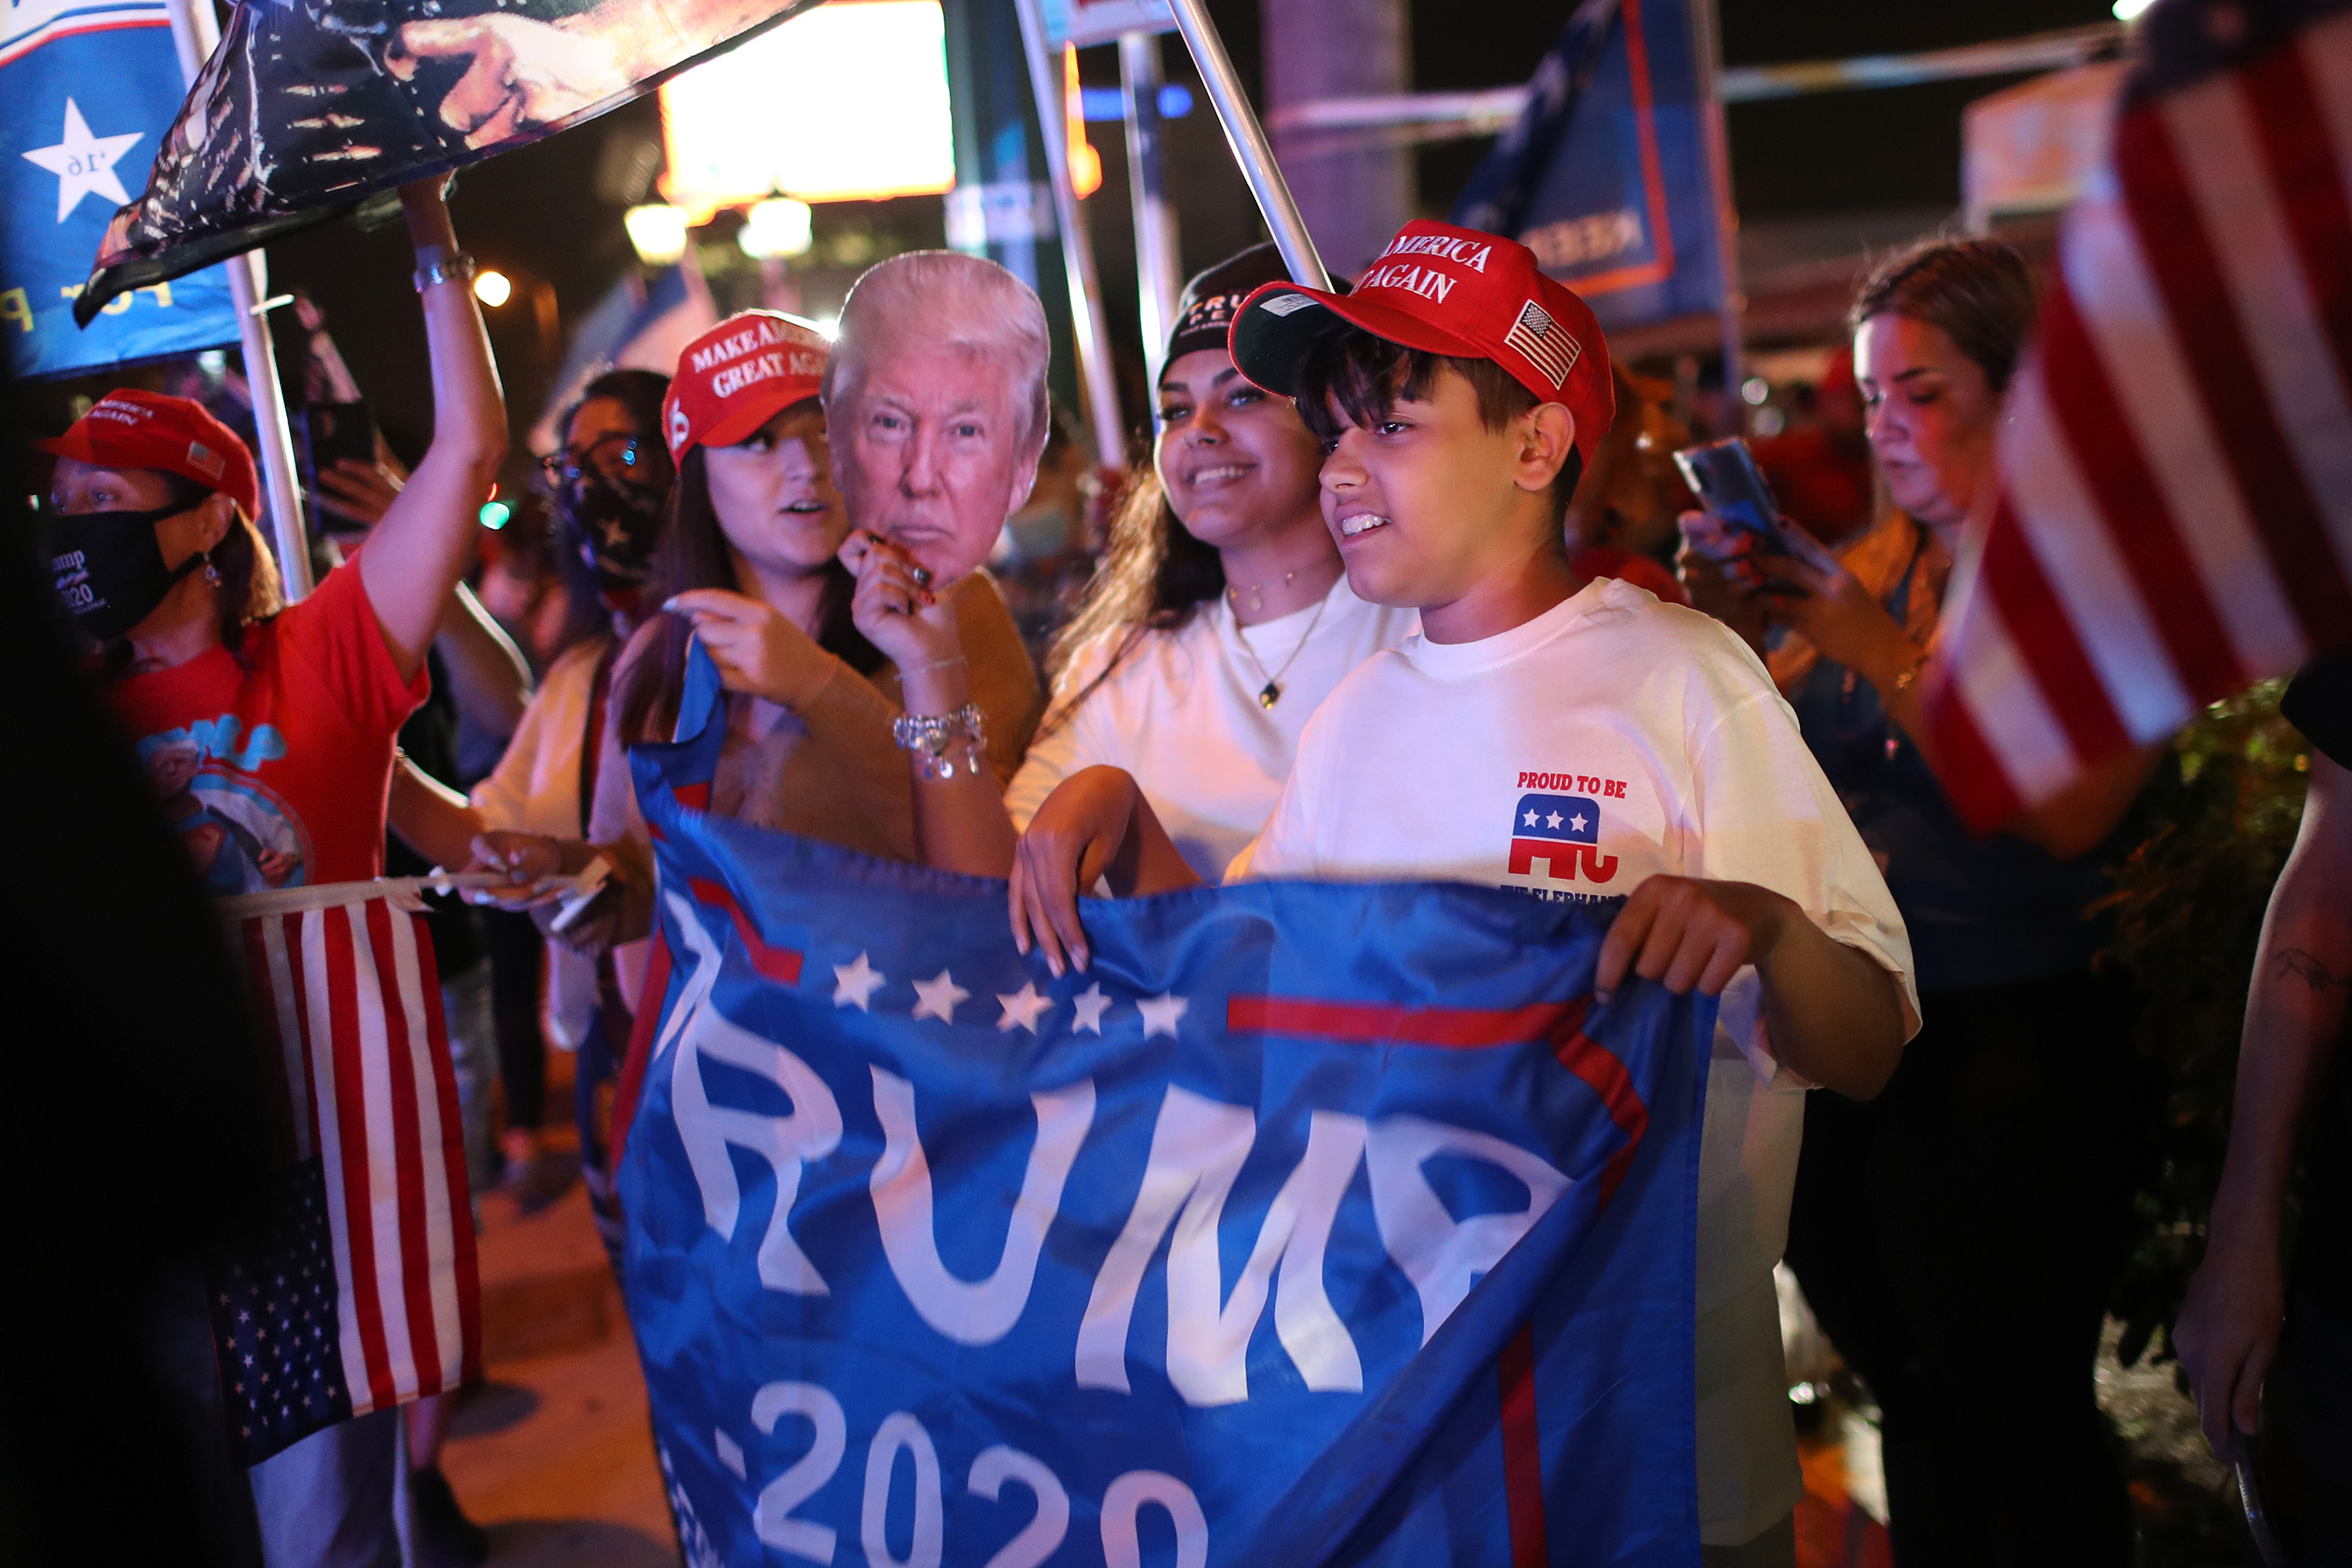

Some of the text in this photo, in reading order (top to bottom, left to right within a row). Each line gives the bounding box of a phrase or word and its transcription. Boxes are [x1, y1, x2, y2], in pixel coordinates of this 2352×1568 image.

[1374, 235, 1493, 274] AMERICA
[1363, 264, 1458, 304] AGAIN
[690, 329, 759, 373] MAKE
[712, 352, 785, 398] GREAT
[1516, 771, 1628, 799] PROUD TO BE
